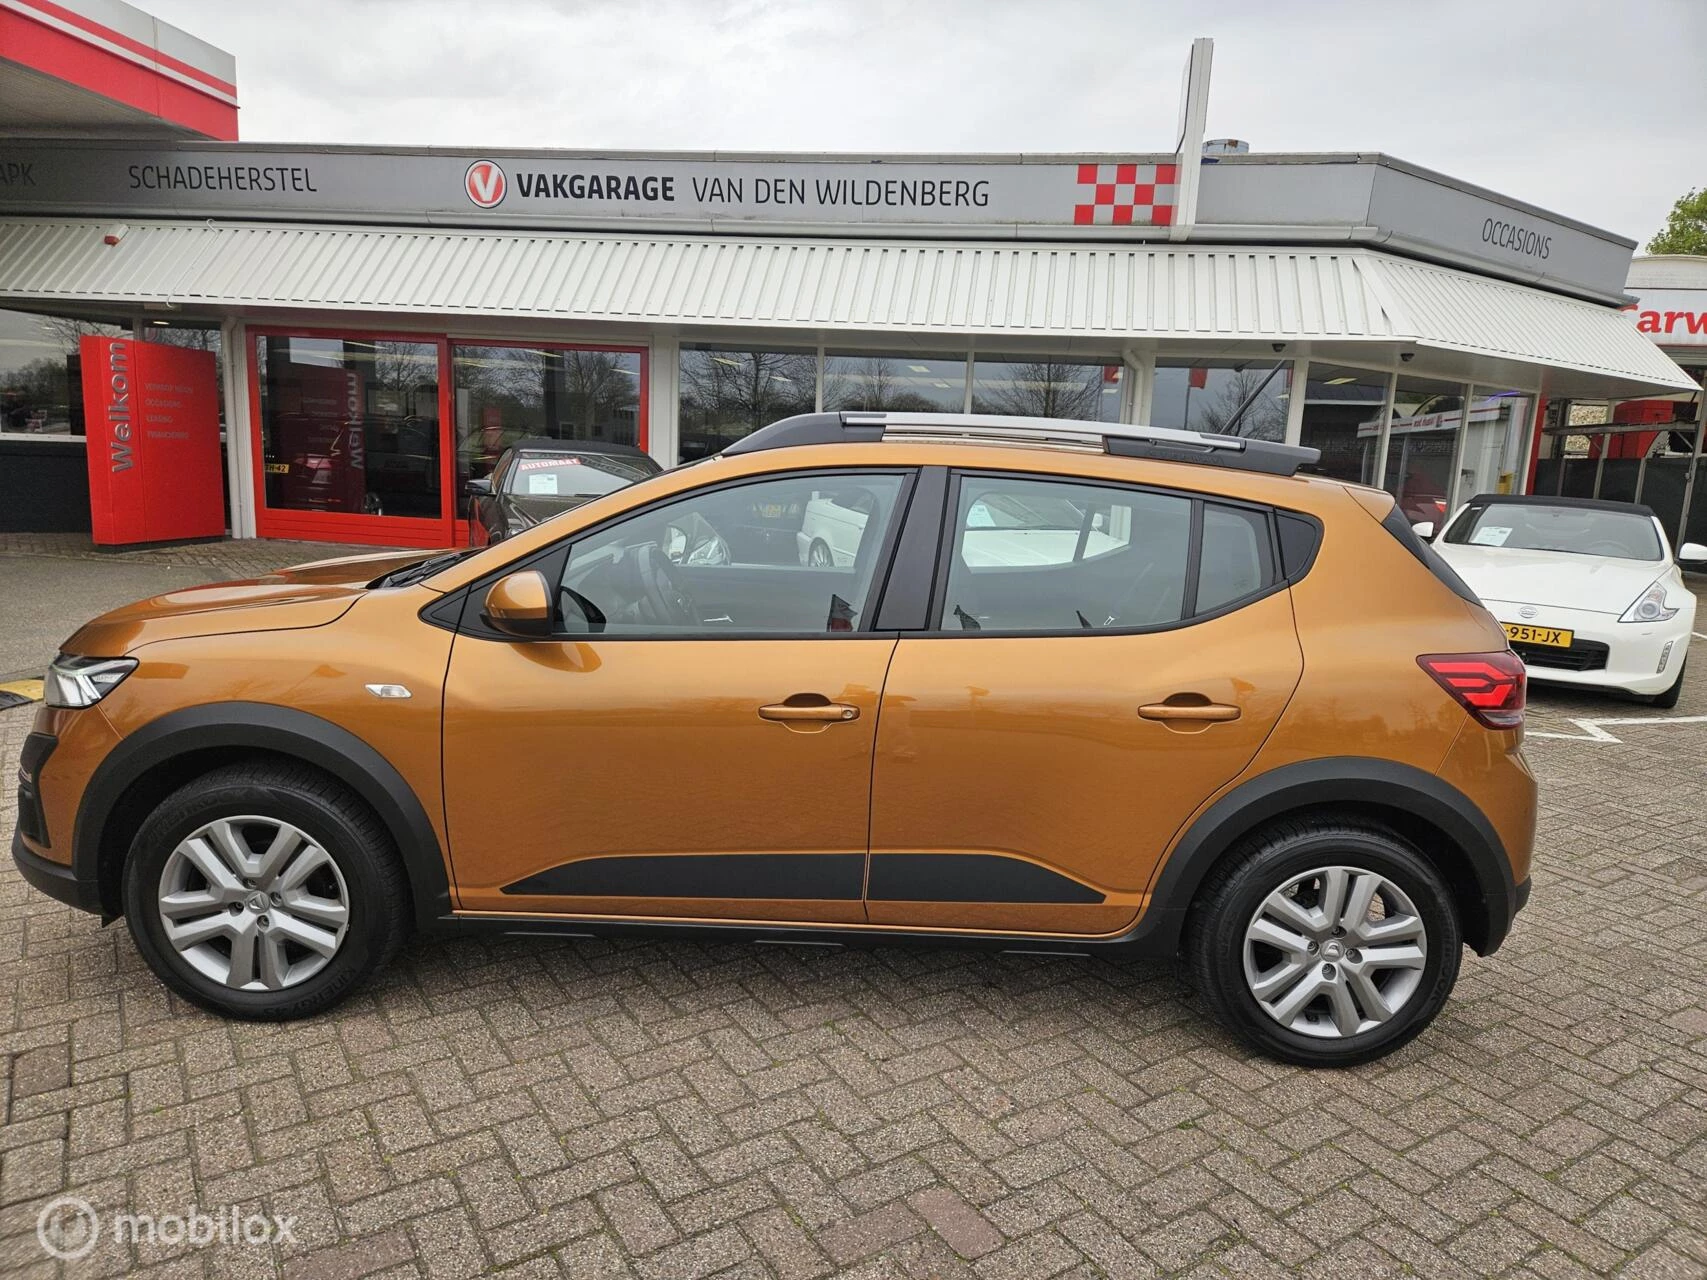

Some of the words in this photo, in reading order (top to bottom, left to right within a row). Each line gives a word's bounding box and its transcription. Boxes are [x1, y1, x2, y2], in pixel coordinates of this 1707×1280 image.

[128, 165, 317, 192] SCHADEHERSTEL
[516, 173, 675, 202] VAKGARAGE
[692, 177, 743, 203] VAN
[755, 178, 805, 204] DEN
[816, 180, 990, 206] WILDENBERG
[1482, 218, 1551, 260] OCCASIONS
[109, 342, 134, 472] Welkom
[521, 458, 580, 470] AUTOMAAT
